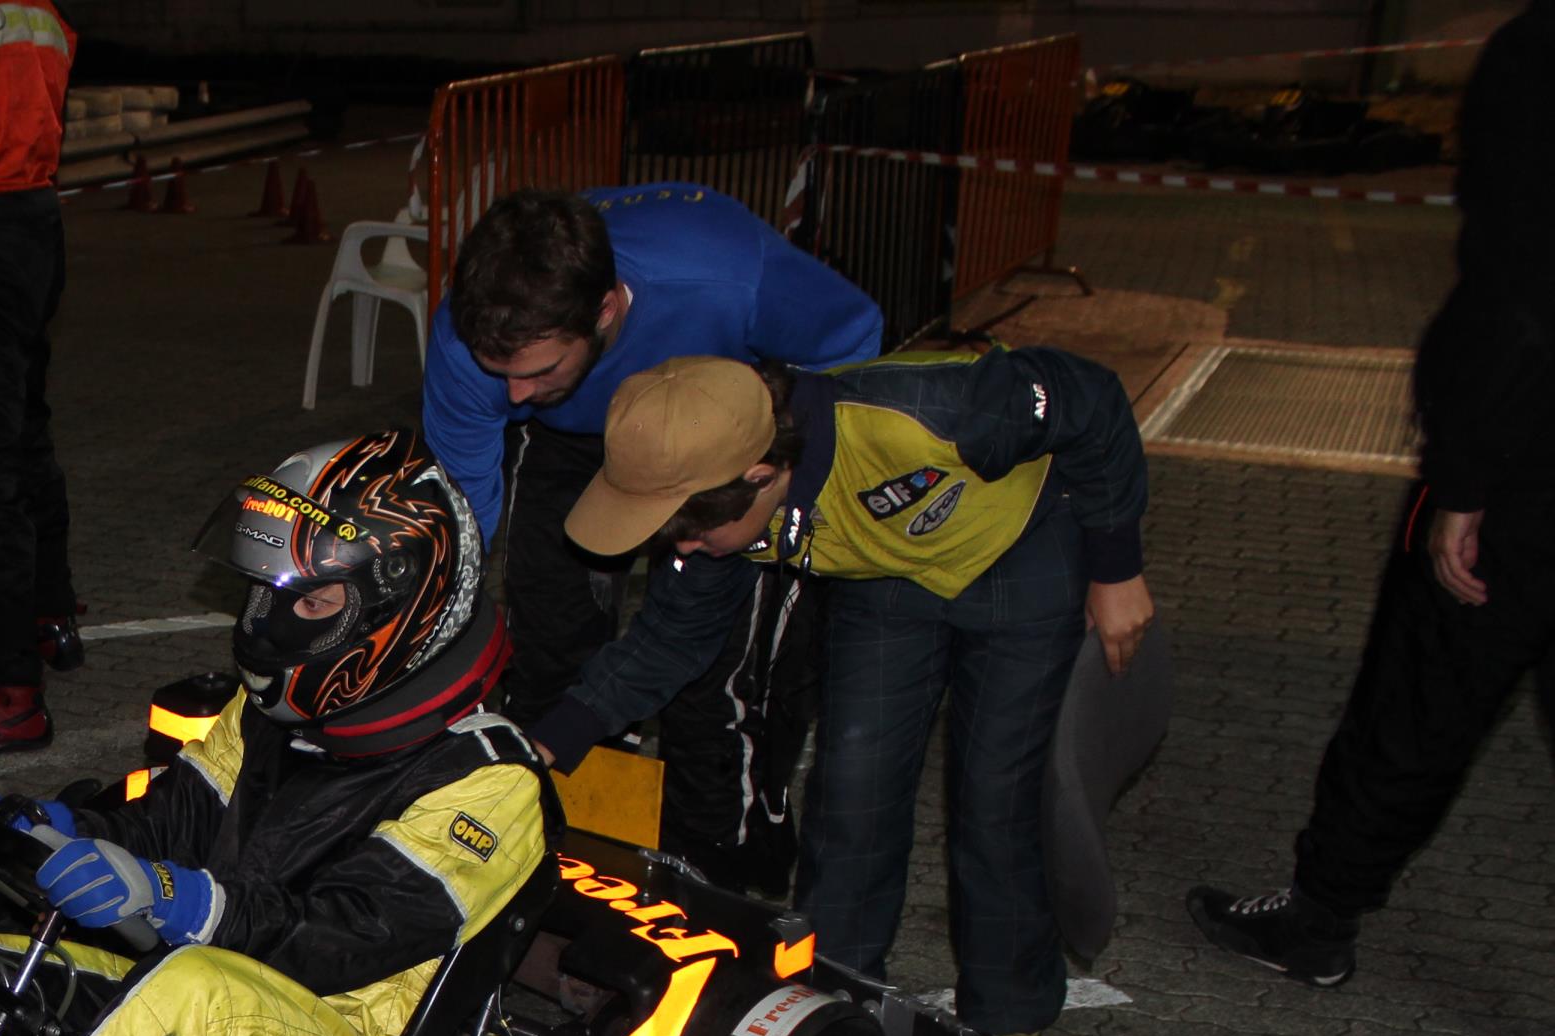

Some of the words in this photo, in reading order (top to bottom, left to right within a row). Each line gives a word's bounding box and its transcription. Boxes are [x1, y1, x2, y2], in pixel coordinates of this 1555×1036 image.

[867, 482, 913, 514] elf
[453, 820, 494, 850] OMP
[557, 856, 739, 962] Free
